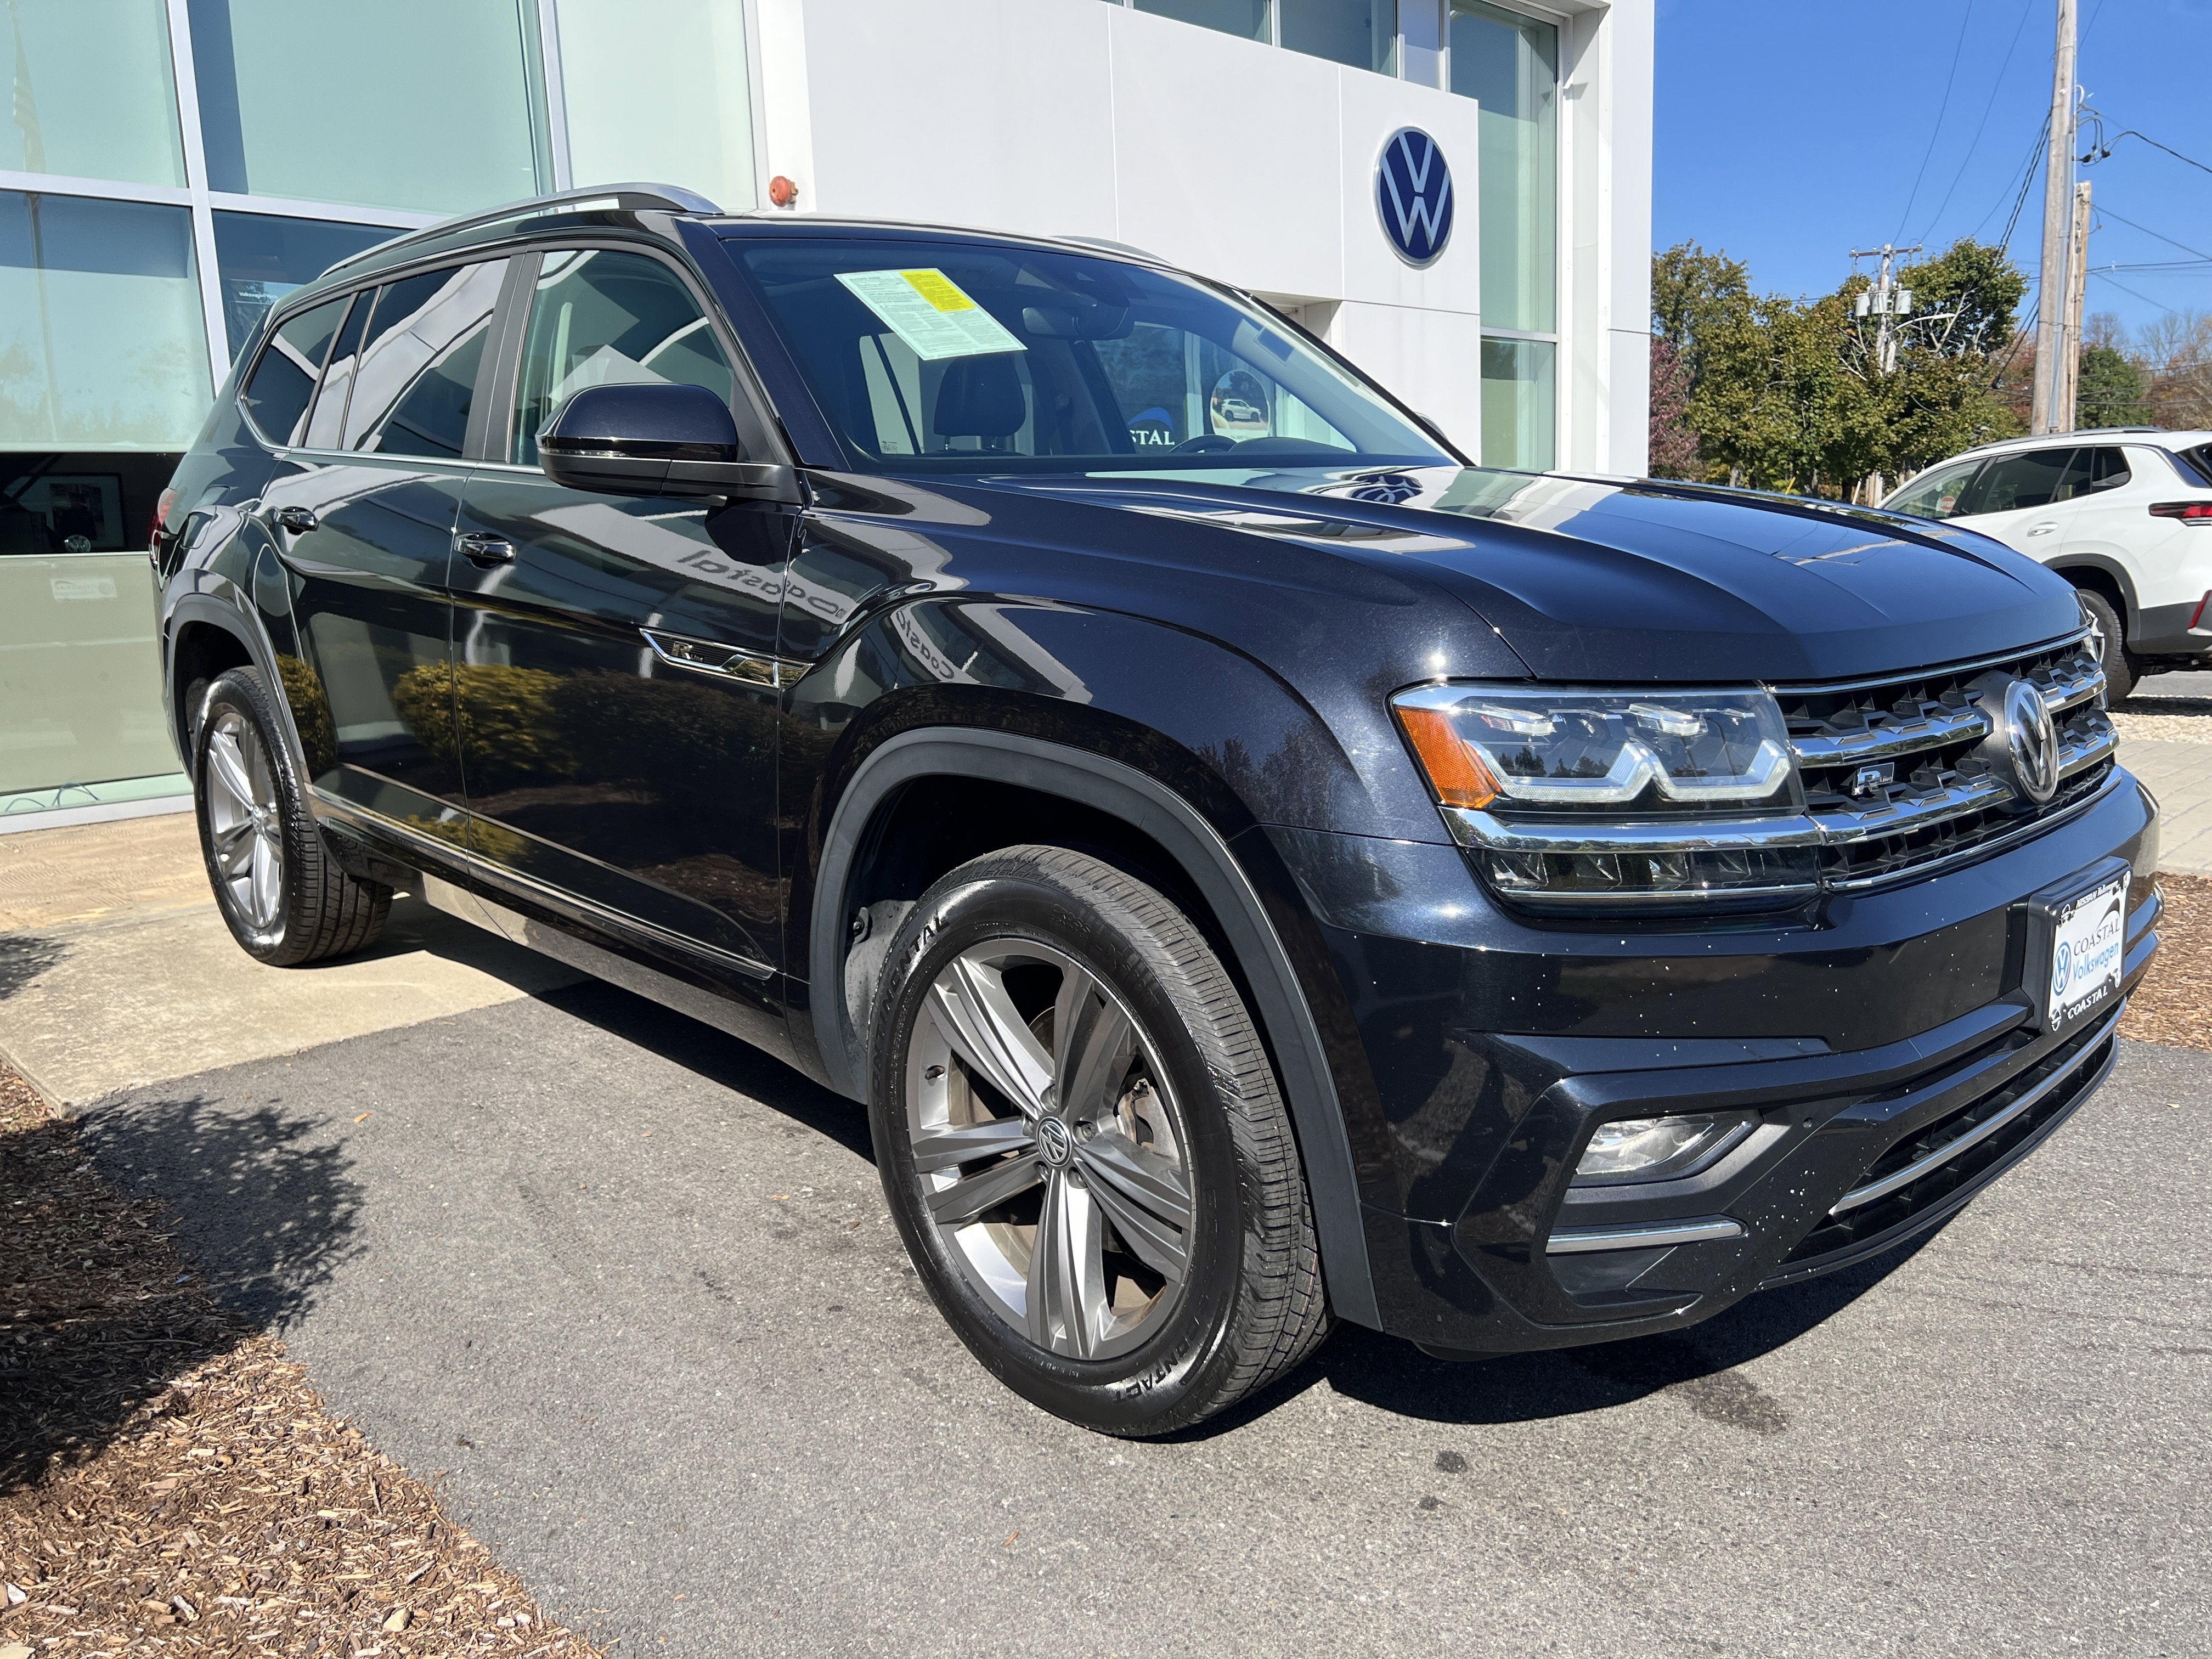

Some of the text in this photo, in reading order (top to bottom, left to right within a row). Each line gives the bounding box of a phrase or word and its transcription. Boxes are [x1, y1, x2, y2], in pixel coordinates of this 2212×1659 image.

[1375, 127, 1454, 264] VW
[2073, 917, 2120, 956] COASTAL
[2072, 941, 2119, 983] Volkswagen
[2067, 985, 2108, 1020] COASTAL
